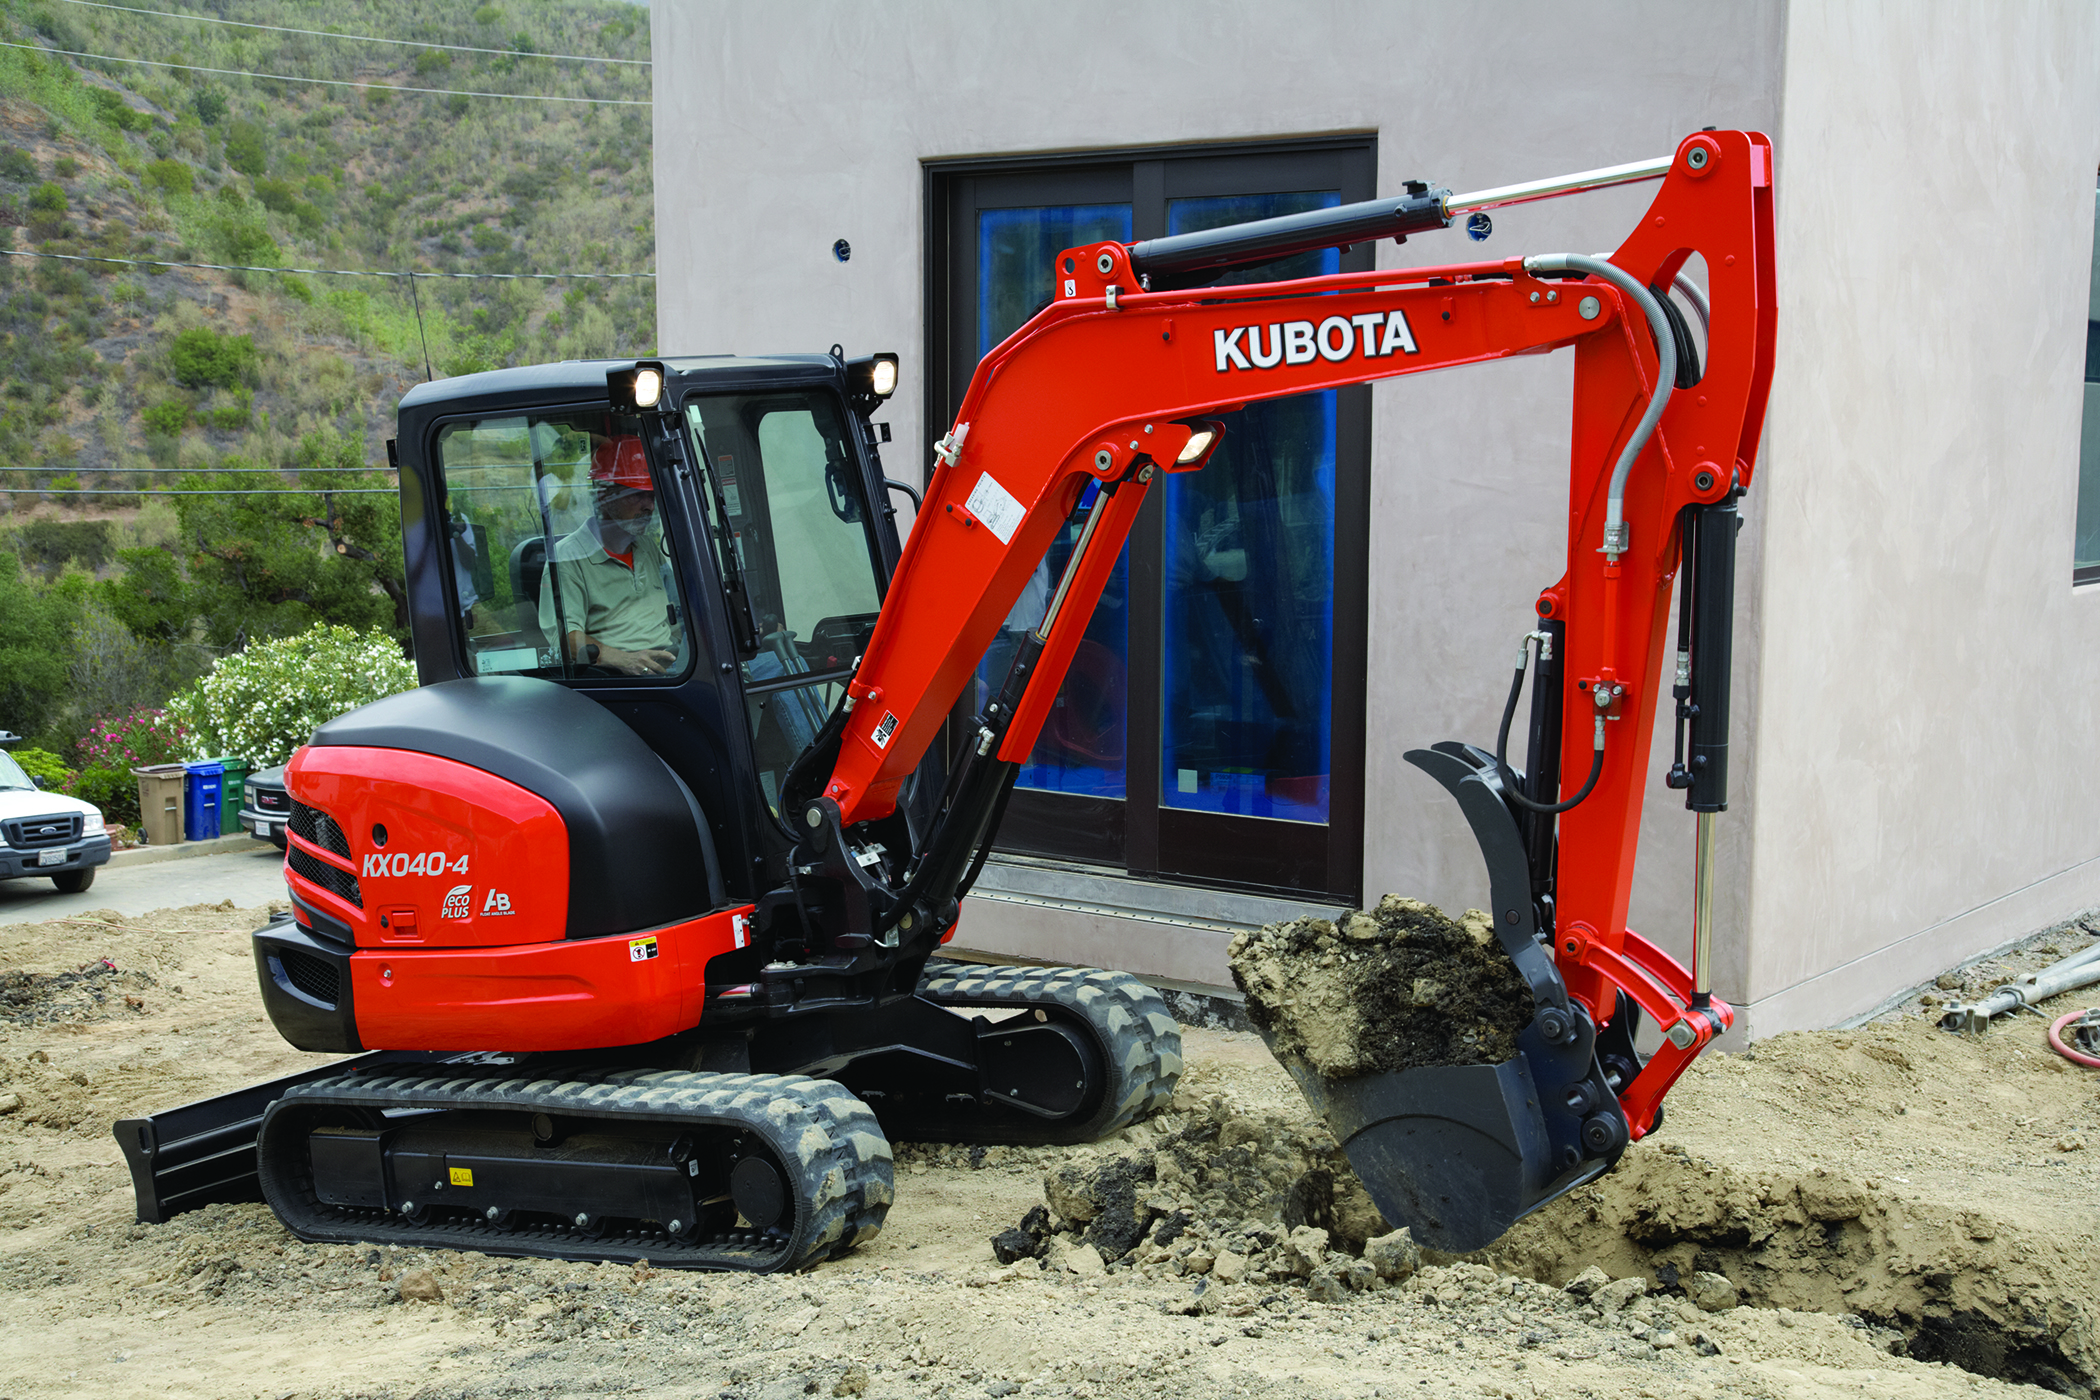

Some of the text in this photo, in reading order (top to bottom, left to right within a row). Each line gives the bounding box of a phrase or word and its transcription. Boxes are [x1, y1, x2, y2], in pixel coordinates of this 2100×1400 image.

[1213, 310, 1419, 372] KUBOTA
[362, 852, 469, 877] KX040-4
[447, 895, 470, 907] eco
[441, 906, 469, 919] PLUS
